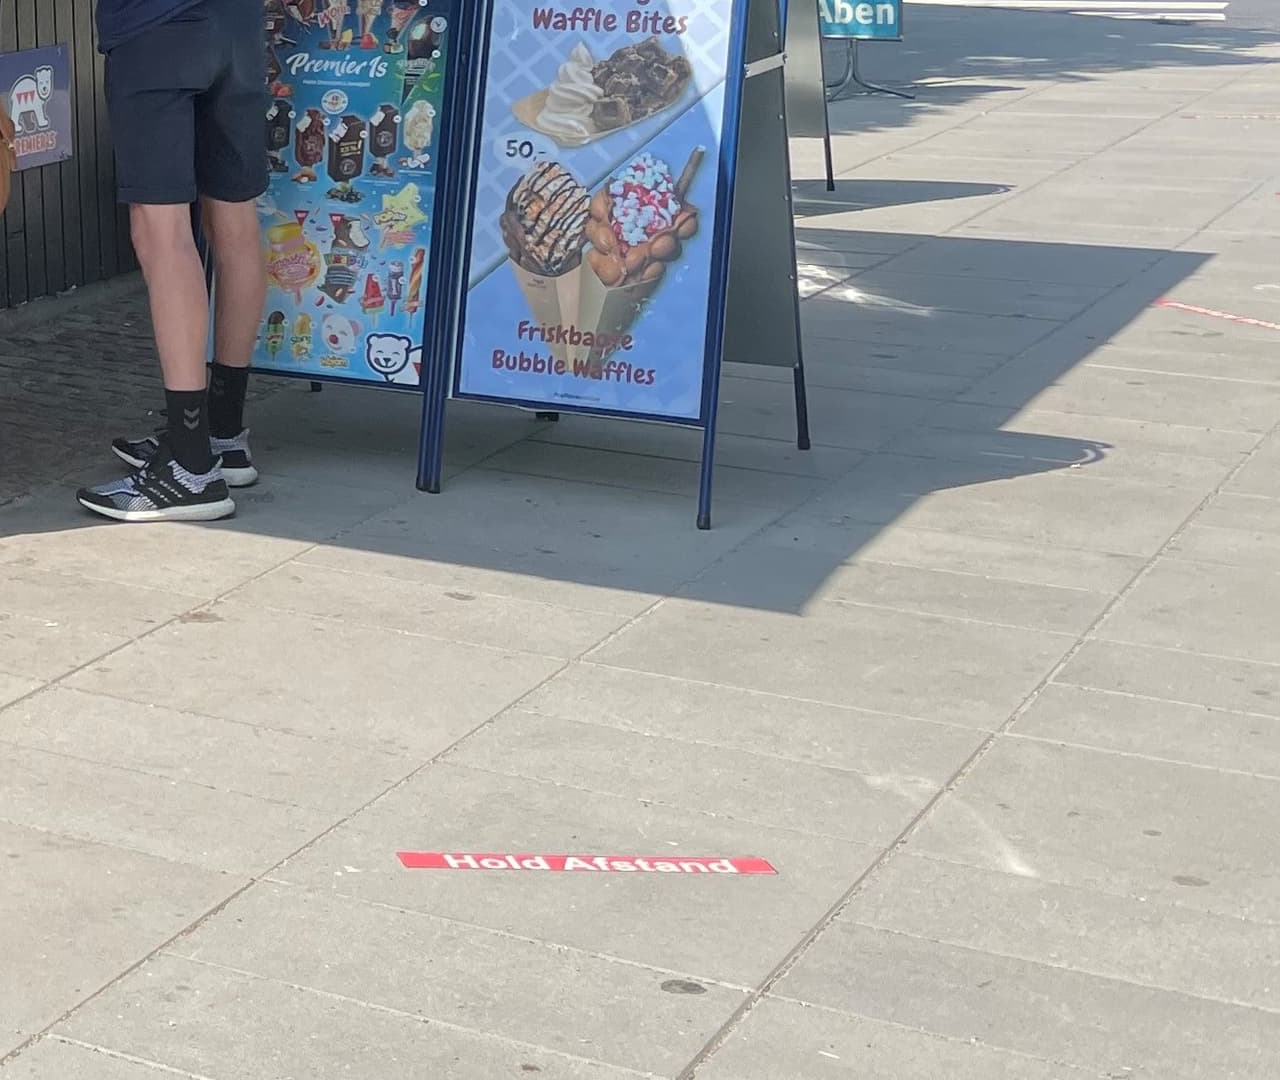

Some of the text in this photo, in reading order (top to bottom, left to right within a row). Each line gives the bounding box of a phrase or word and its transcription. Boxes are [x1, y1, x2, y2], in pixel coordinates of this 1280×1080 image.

[533, 7, 688, 35] Waffle Bites
[286, 52, 388, 78] Premier Is
[14, 133, 46, 156] REMIER
[505, 139, 546, 161] 50,-
[518, 321, 633, 358] Friskbagte
[492, 349, 656, 385] Bubble Waffles
[443, 854, 739, 873] Hold Afstand
